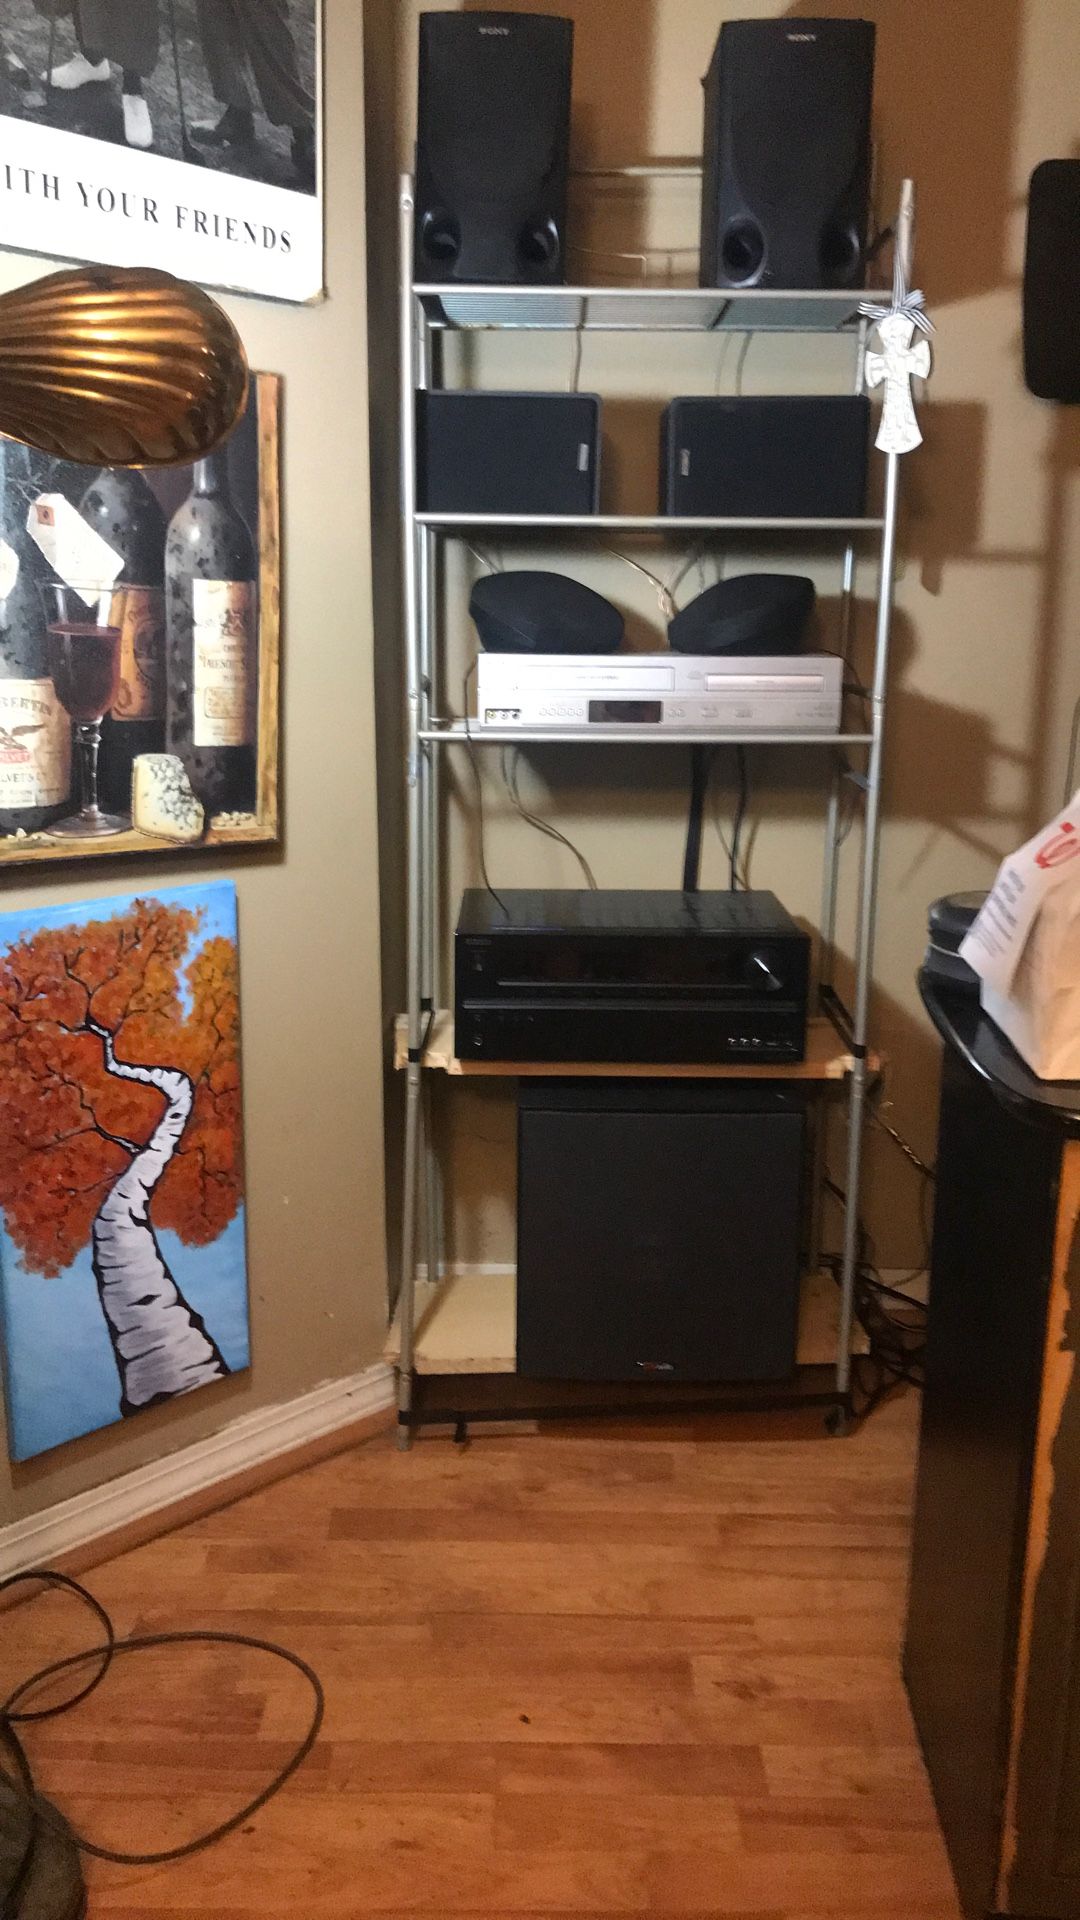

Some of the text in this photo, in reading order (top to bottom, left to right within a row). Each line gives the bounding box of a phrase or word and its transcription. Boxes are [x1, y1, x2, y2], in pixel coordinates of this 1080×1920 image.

[5, 165, 291, 252] ITH YOUR FRIENDS
